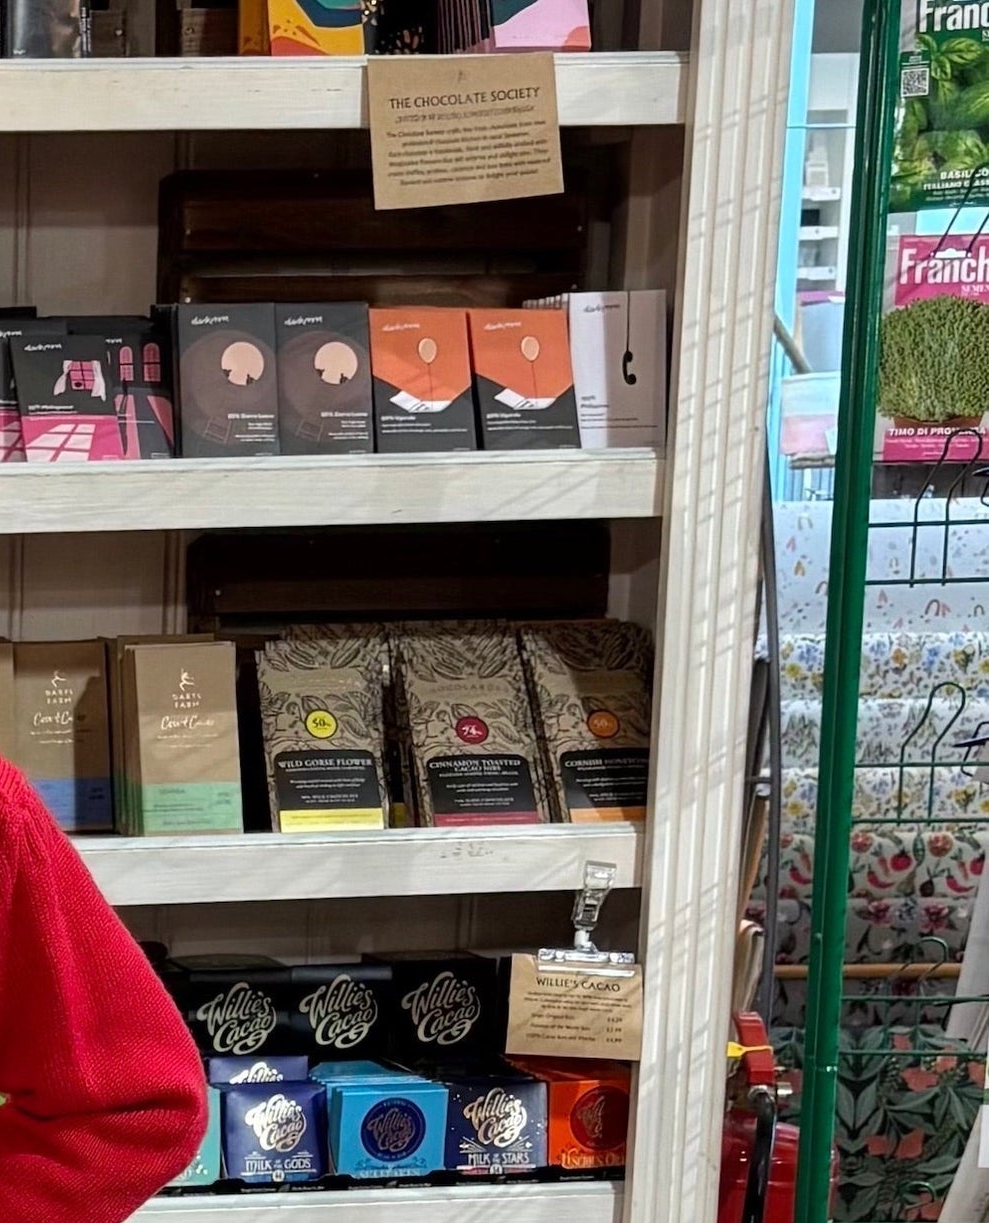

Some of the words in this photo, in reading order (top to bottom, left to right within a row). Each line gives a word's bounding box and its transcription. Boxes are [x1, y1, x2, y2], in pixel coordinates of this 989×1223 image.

[390, 98, 410, 110] THE
[414, 92, 488, 108] CHOCOLATE
[491, 87, 540, 101] SOCIETY
[889, 428, 914, 437] TIMO
[278, 760, 304, 770] WILD
[305, 759, 336, 768] GORSE
[337, 758, 374, 767] FLOWER
[429, 760, 479, 770] CINNAMON
[481, 759, 522, 768] TOASTED
[536, 976, 579, 989] WILLIE'S
[581, 980, 621, 993] CACAO
[315, 1004, 378, 1048] Cacao
[418, 1001, 481, 1045] Cacao
[213, 1010, 277, 1055] Cacao
[477, 1109, 527, 1148] Cacao
[246, 1158, 272, 1172] MILK
[284, 1157, 311, 1169] GODS
[468, 1153, 490, 1166] MILK
[502, 1152, 530, 1164] STARS
